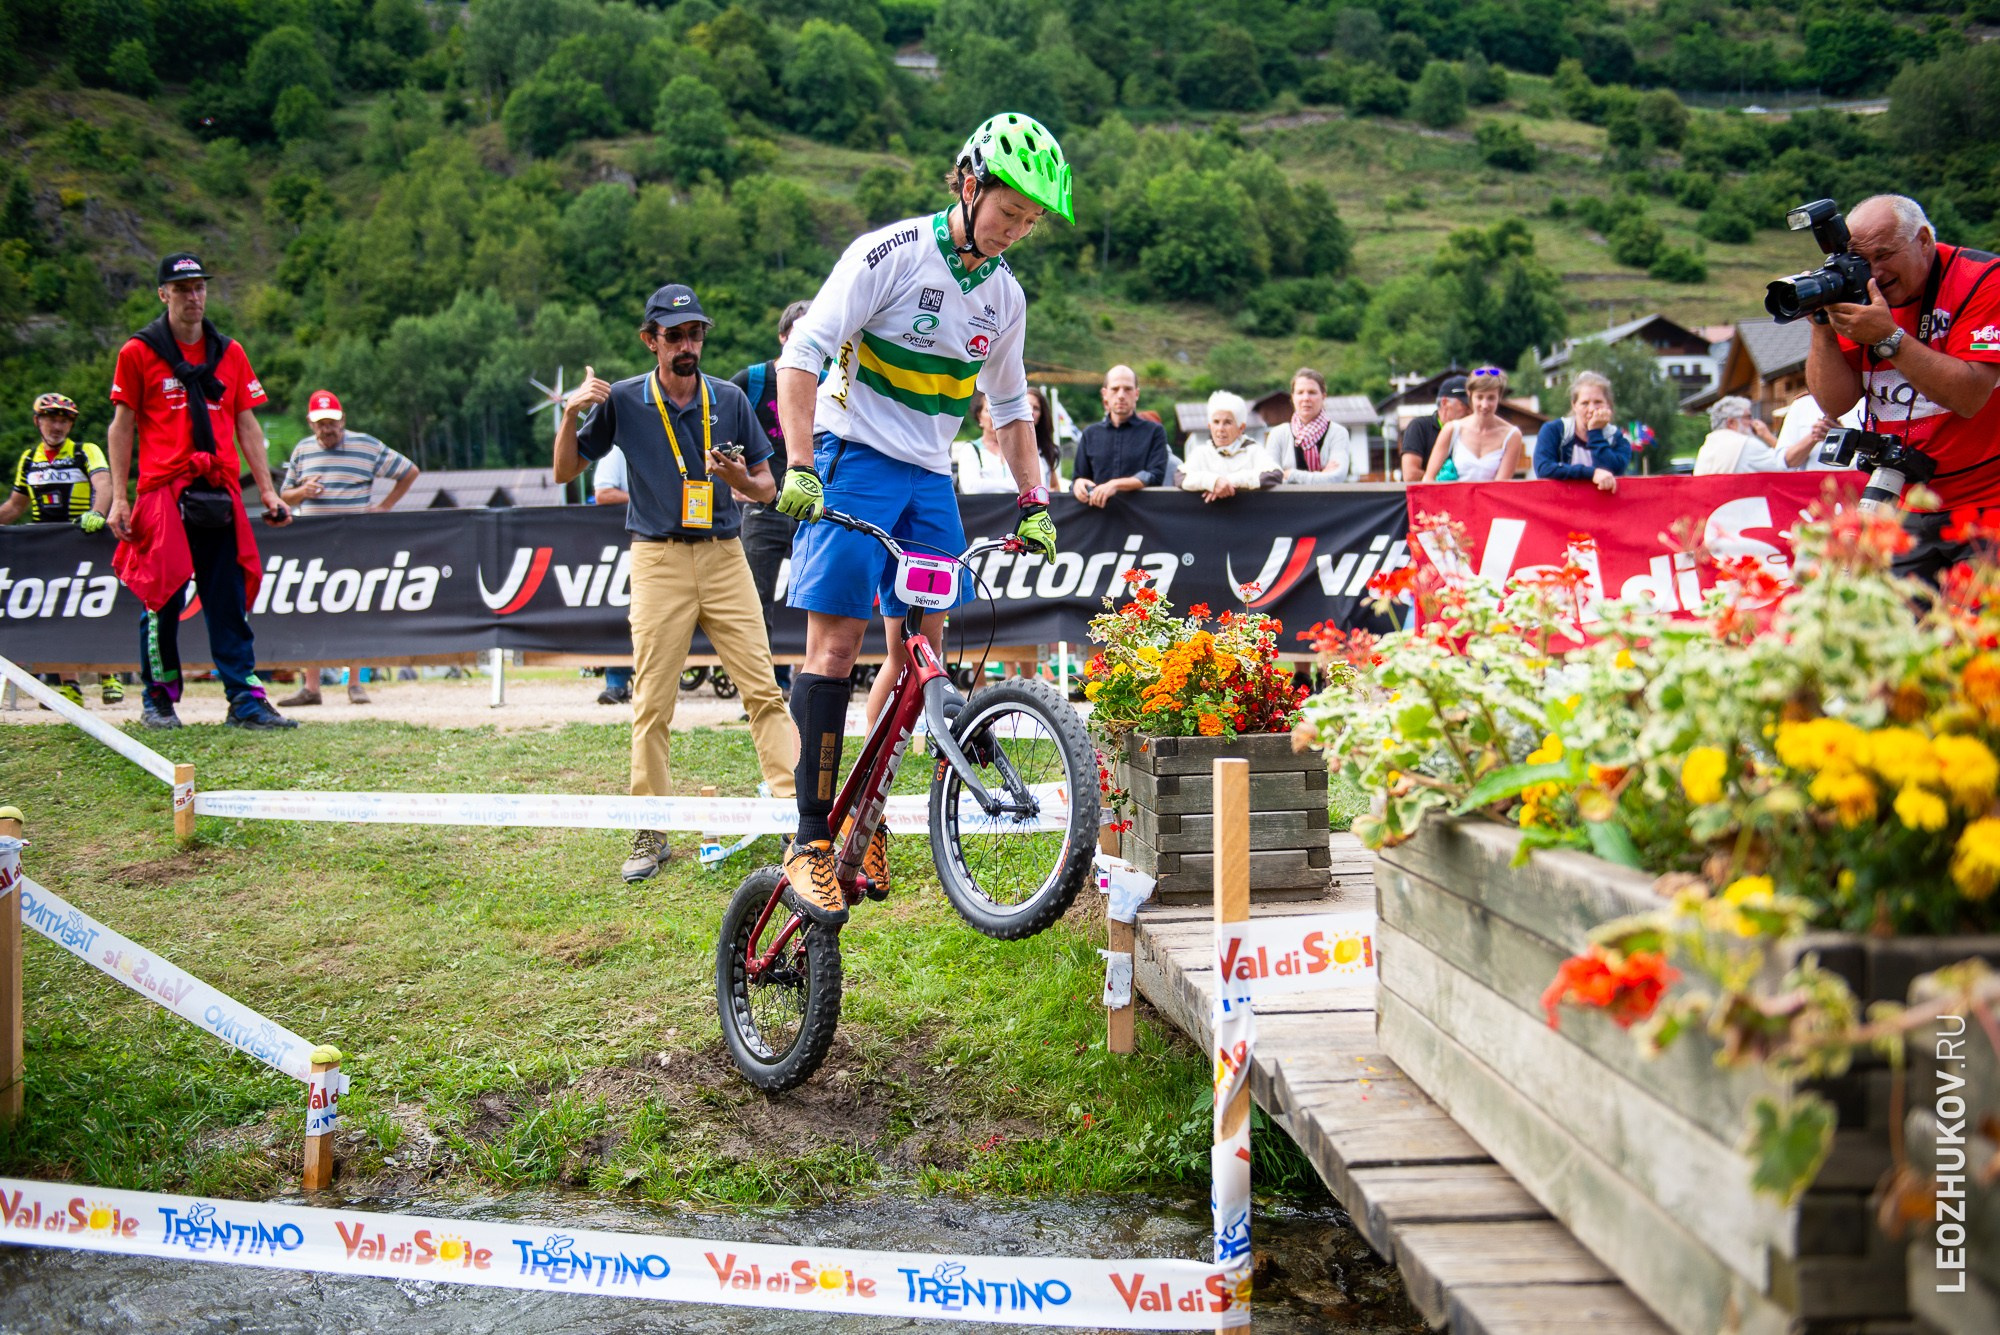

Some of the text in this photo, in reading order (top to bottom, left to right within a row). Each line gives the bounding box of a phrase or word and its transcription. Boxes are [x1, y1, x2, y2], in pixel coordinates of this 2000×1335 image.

[865, 226, 918, 270] Santini
[902, 332, 935, 348] Cycling
[1919, 314, 1930, 339] EOS
[252, 551, 440, 614] ittoria
[927, 572, 935, 593] 1
[972, 534, 1179, 600] ttoria
[864, 726, 912, 832] CLEAN
[1275, 951, 1301, 976] di
[0, 1188, 41, 1229] Val
[44, 1208, 66, 1232] di
[159, 1205, 304, 1257] TRENTINO
[335, 1221, 386, 1261] Val
[390, 1242, 412, 1264] di
[513, 1238, 671, 1287] TRENTINO
[704, 1252, 761, 1291] Val
[766, 1271, 790, 1293] di
[898, 1264, 1071, 1314] TRENTINO
[1109, 1273, 1171, 1314] Val
[1177, 1287, 1204, 1312] di
